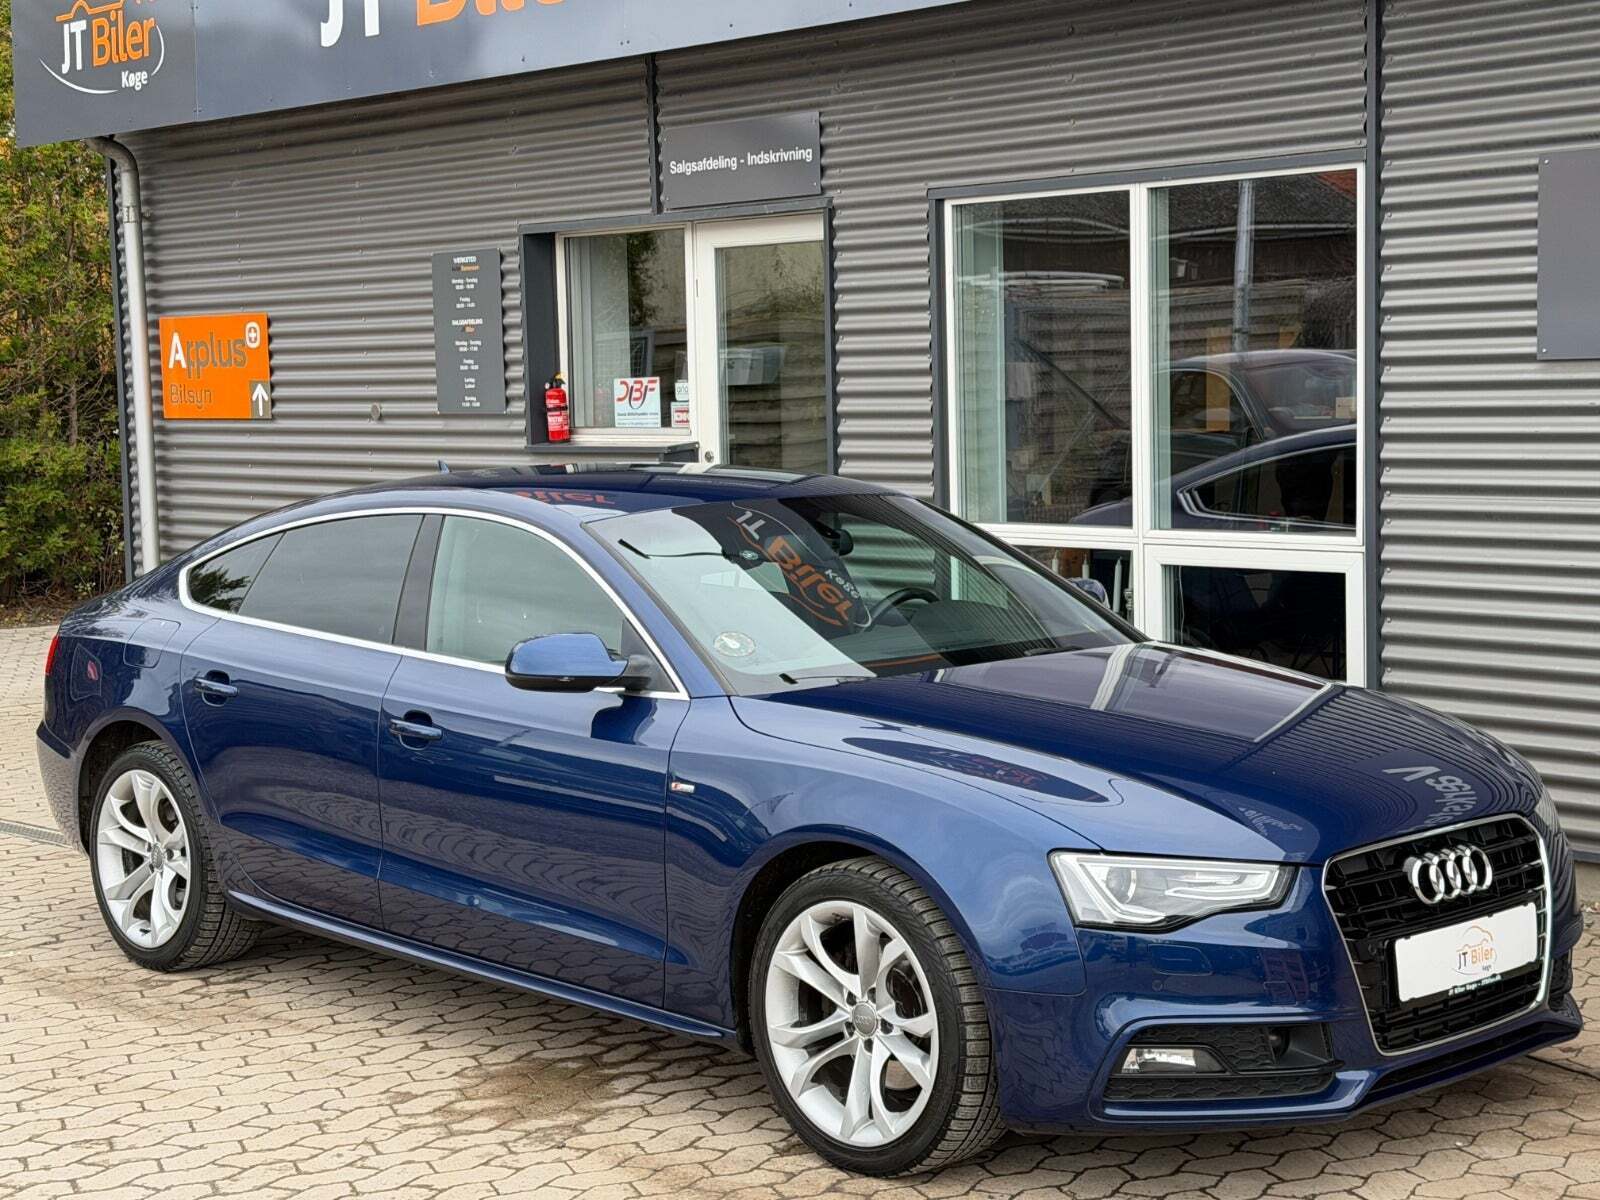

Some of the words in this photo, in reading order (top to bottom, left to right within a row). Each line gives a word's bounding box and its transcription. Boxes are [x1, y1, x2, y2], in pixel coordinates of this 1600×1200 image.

[62, 20, 87, 74] JT
[92, 9, 155, 67] Biler
[121, 70, 148, 91] Køge
[669, 155, 738, 176] Salgsafdeling
[747, 146, 813, 166] Indskrivning
[170, 383, 213, 410] Bilsyn
[1457, 951, 1468, 970] JT
[1471, 946, 1494, 965] Biler
